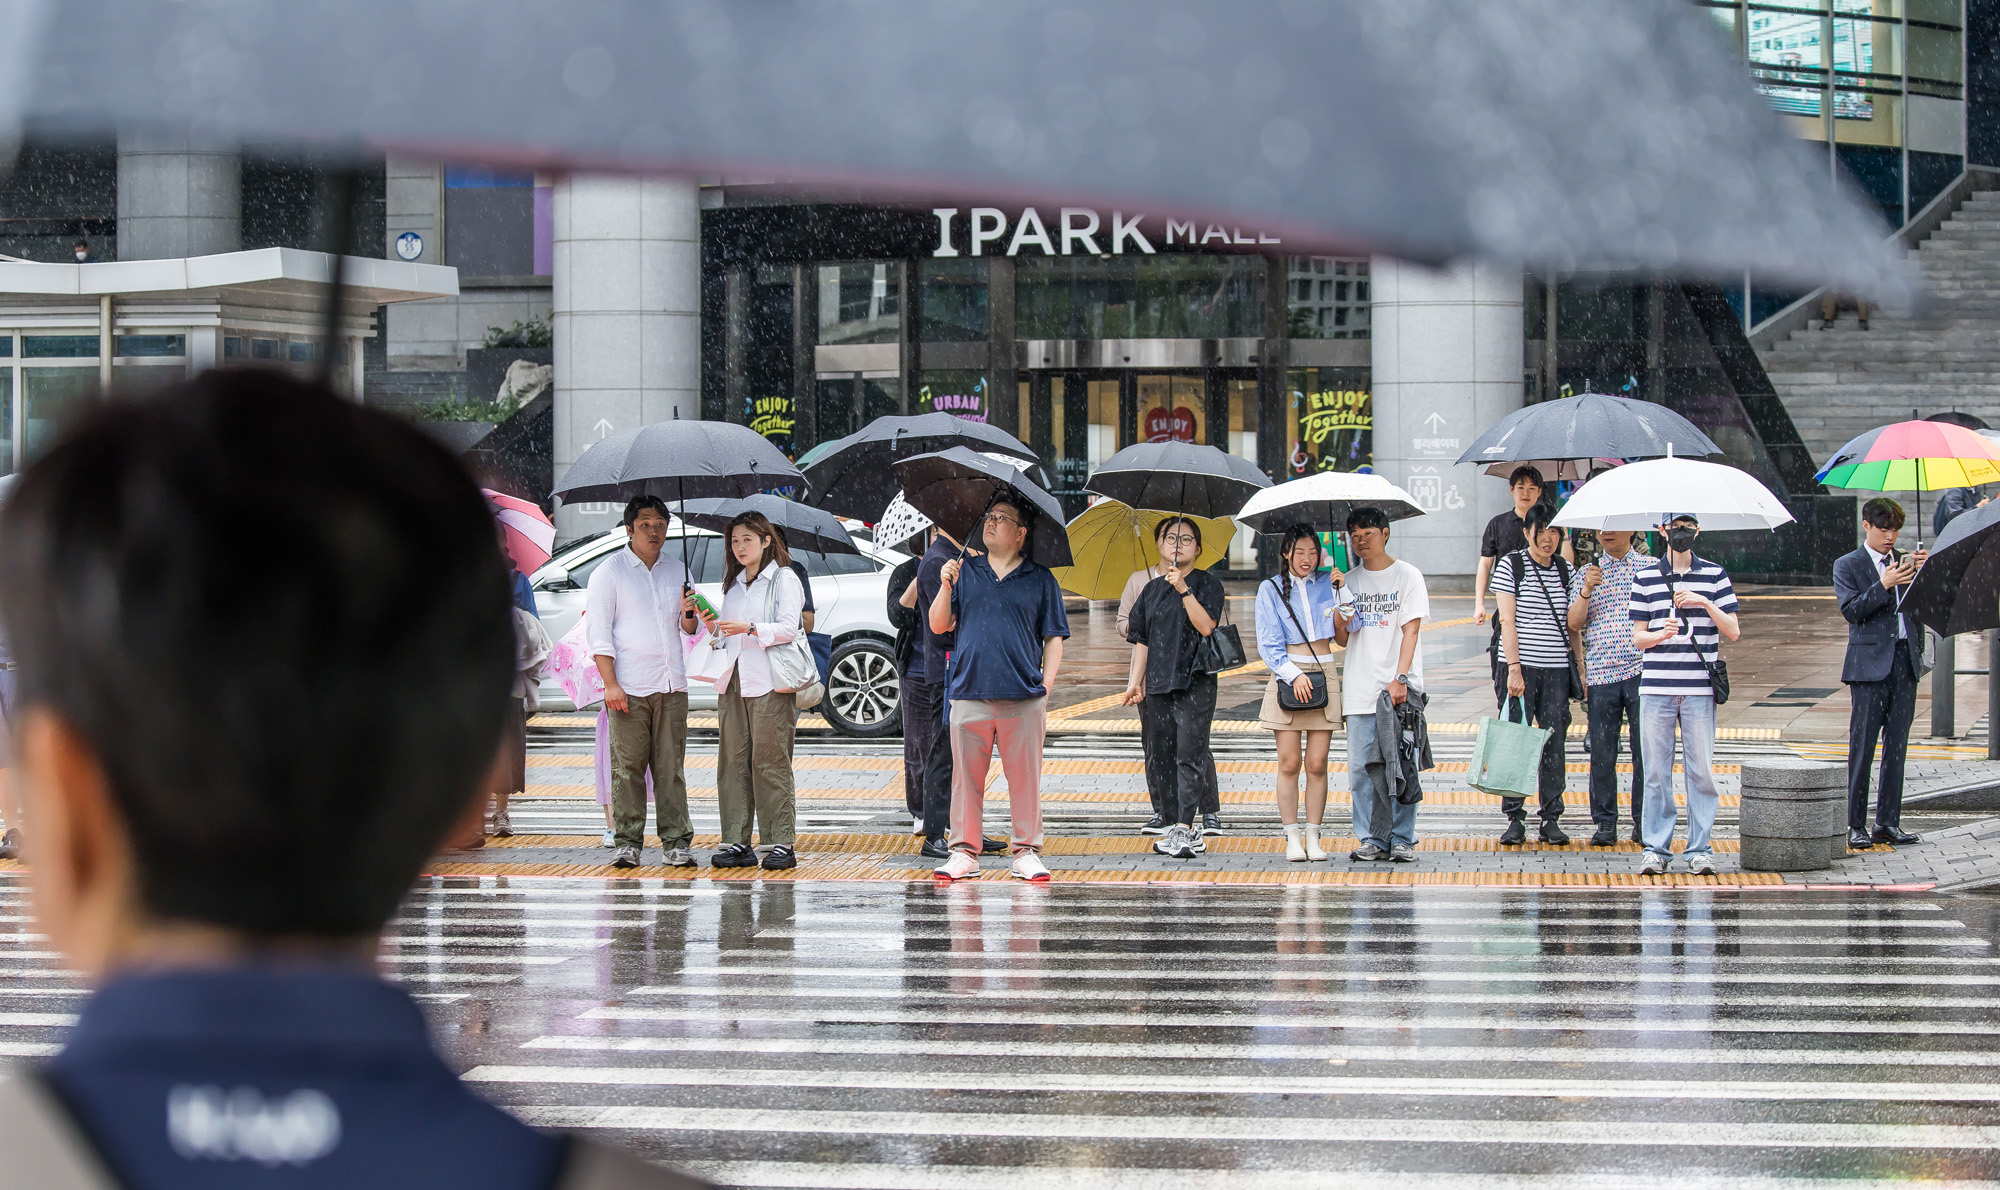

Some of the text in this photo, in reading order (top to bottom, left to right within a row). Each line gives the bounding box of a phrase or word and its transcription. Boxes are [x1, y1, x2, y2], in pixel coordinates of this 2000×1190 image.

[755, 396, 789, 414] ENJOY
[933, 394, 980, 411] URBAN
[1310, 390, 1369, 409] ENJOY
[749, 414, 796, 437] Together
[1151, 417, 1188, 433] ENJOY
[1299, 409, 1373, 444] Together
[1353, 590, 1399, 603] Collection of
[1362, 620, 1378, 628] quare
